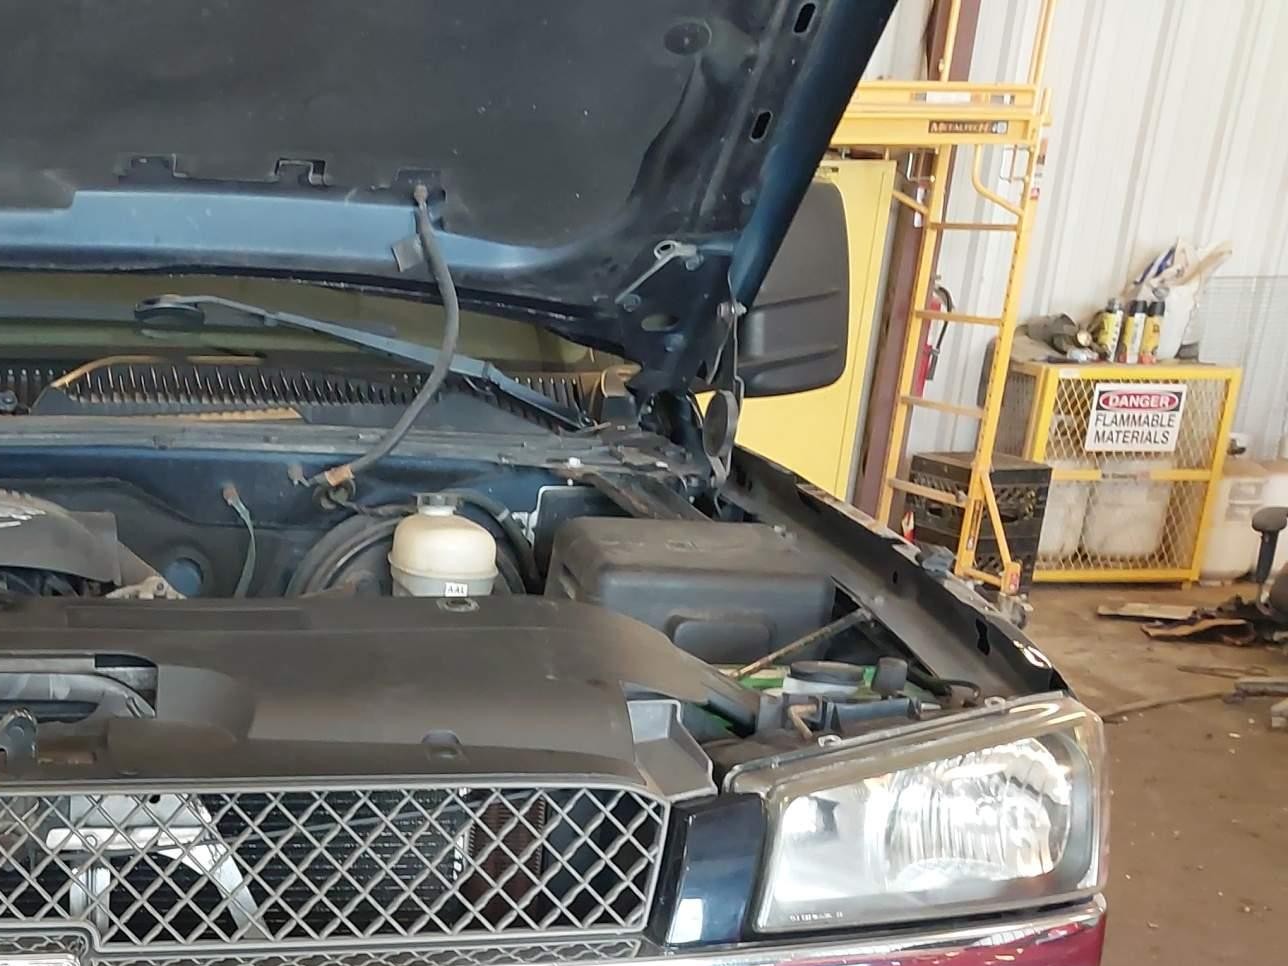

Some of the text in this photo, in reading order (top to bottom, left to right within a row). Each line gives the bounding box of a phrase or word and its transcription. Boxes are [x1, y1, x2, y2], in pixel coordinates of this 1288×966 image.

[1108, 394, 1170, 409] DANGER
[1094, 413, 1176, 428] FLAMMABLE
[1094, 430, 1170, 444] MATERIALS
